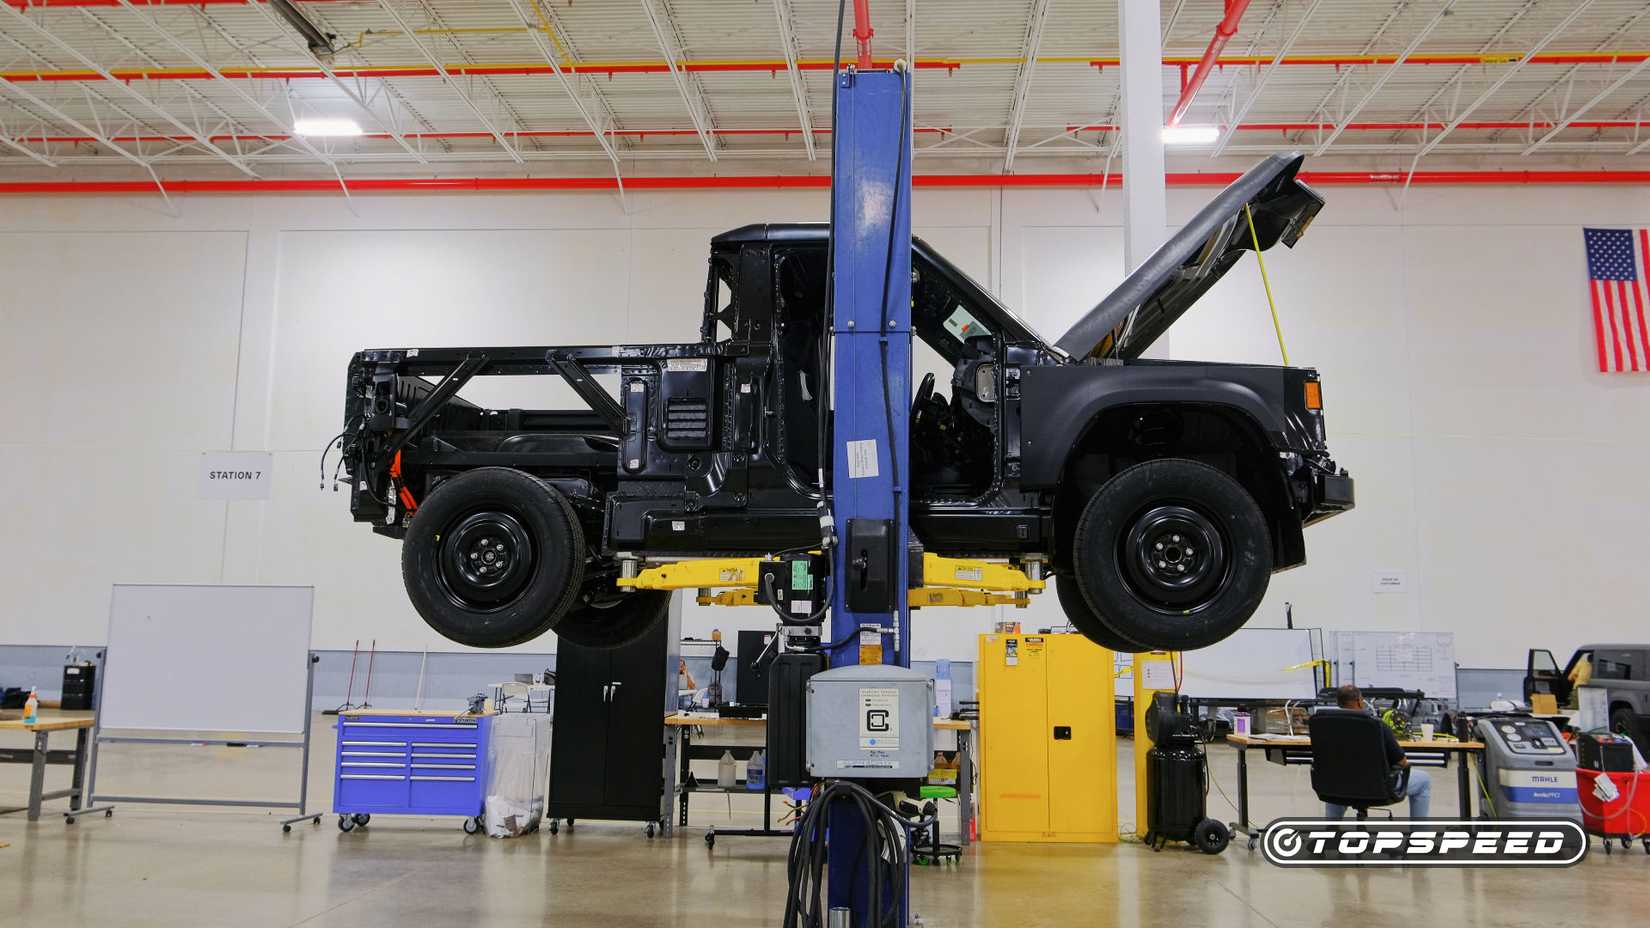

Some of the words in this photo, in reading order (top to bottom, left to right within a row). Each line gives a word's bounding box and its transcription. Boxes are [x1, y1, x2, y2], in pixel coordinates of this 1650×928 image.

[209, 471, 252, 480] STATION
[256, 471, 261, 479] 7
[1531, 775, 1559, 783] MAHLE
